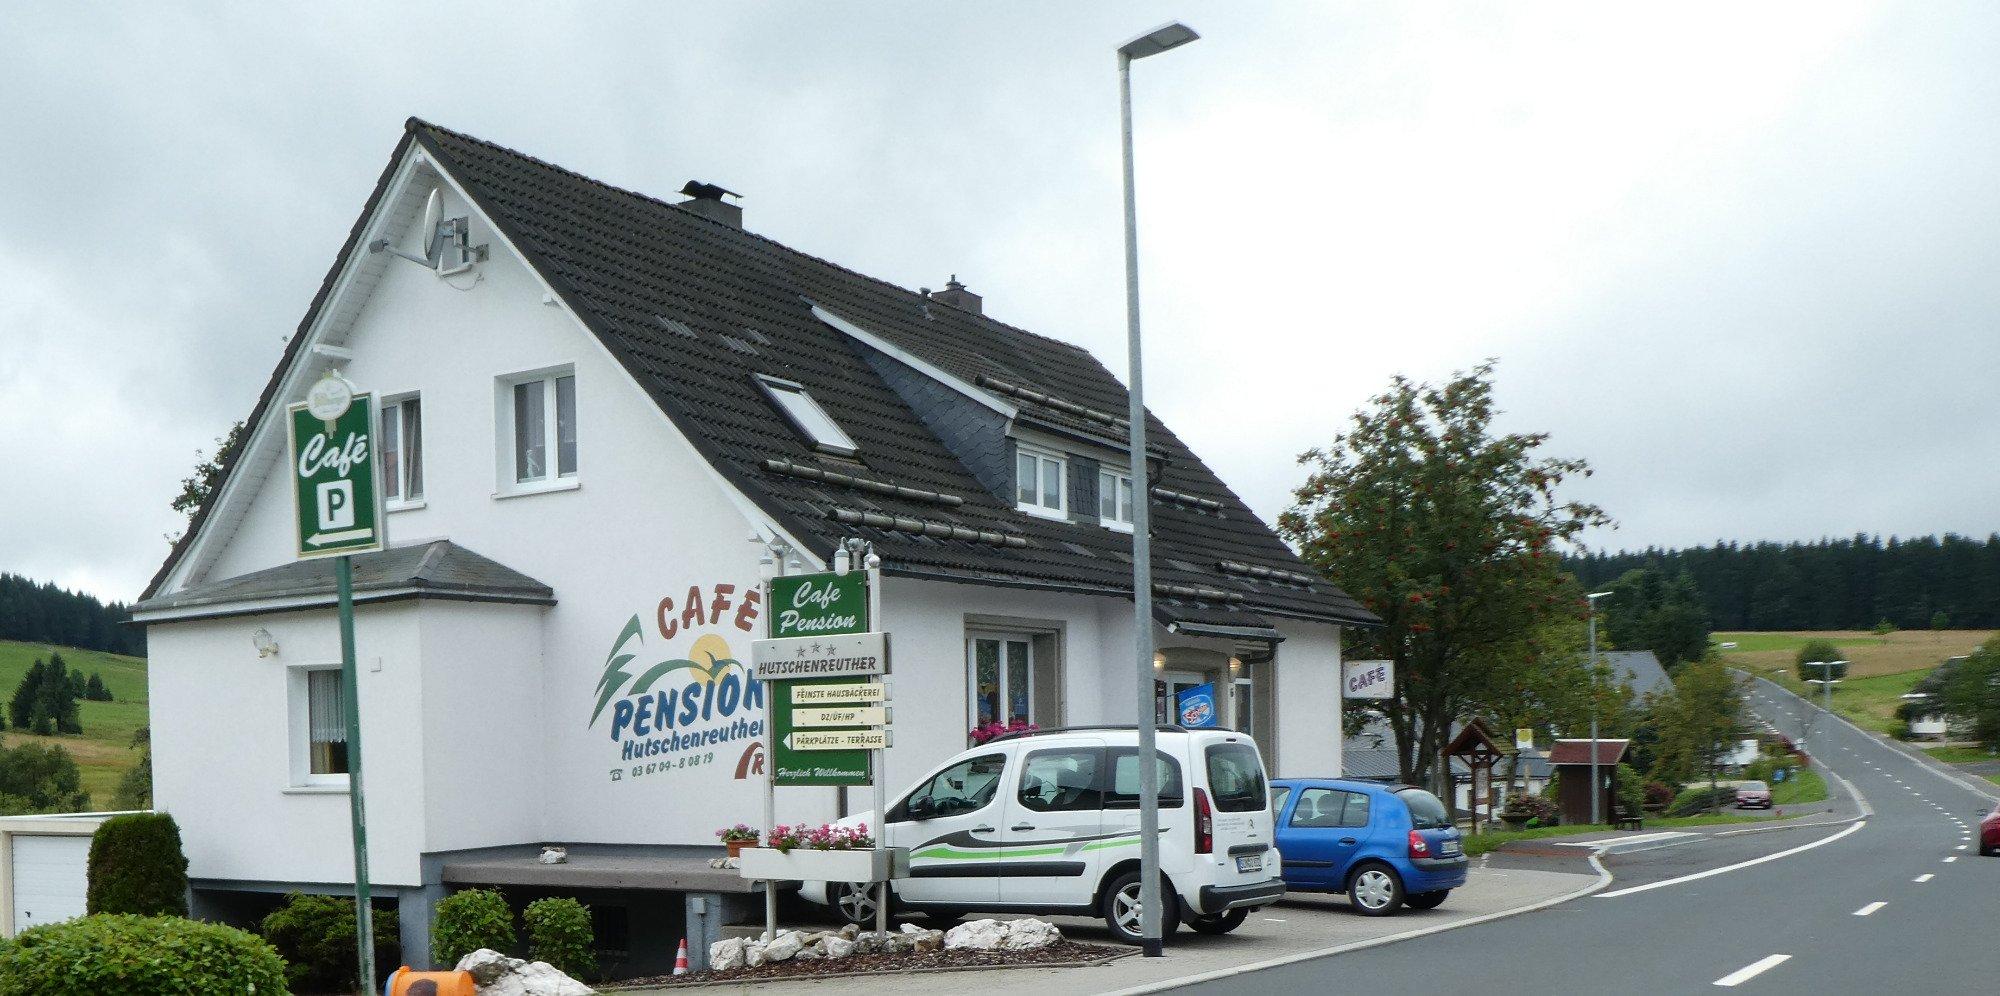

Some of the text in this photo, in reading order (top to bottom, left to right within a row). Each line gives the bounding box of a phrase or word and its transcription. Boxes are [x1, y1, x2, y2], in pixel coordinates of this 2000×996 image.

[299, 432, 368, 478] Café
[327, 488, 345, 521] P
[793, 581, 841, 609] Cafe
[780, 609, 856, 634] Pension
[758, 656, 877, 675] HUTSCHENREUTHER
[796, 687, 880, 699] FEINSTE HAUSBÄCKEREI
[796, 735, 839, 745] PARKPLÄTZE
[847, 735, 883, 744] TERRASSE
[632, 765, 643, 777] 03
[645, 762, 657, 775] 67
[702, 751, 714, 764] 19
[776, 767, 866, 780] Herzlich Willkommen
